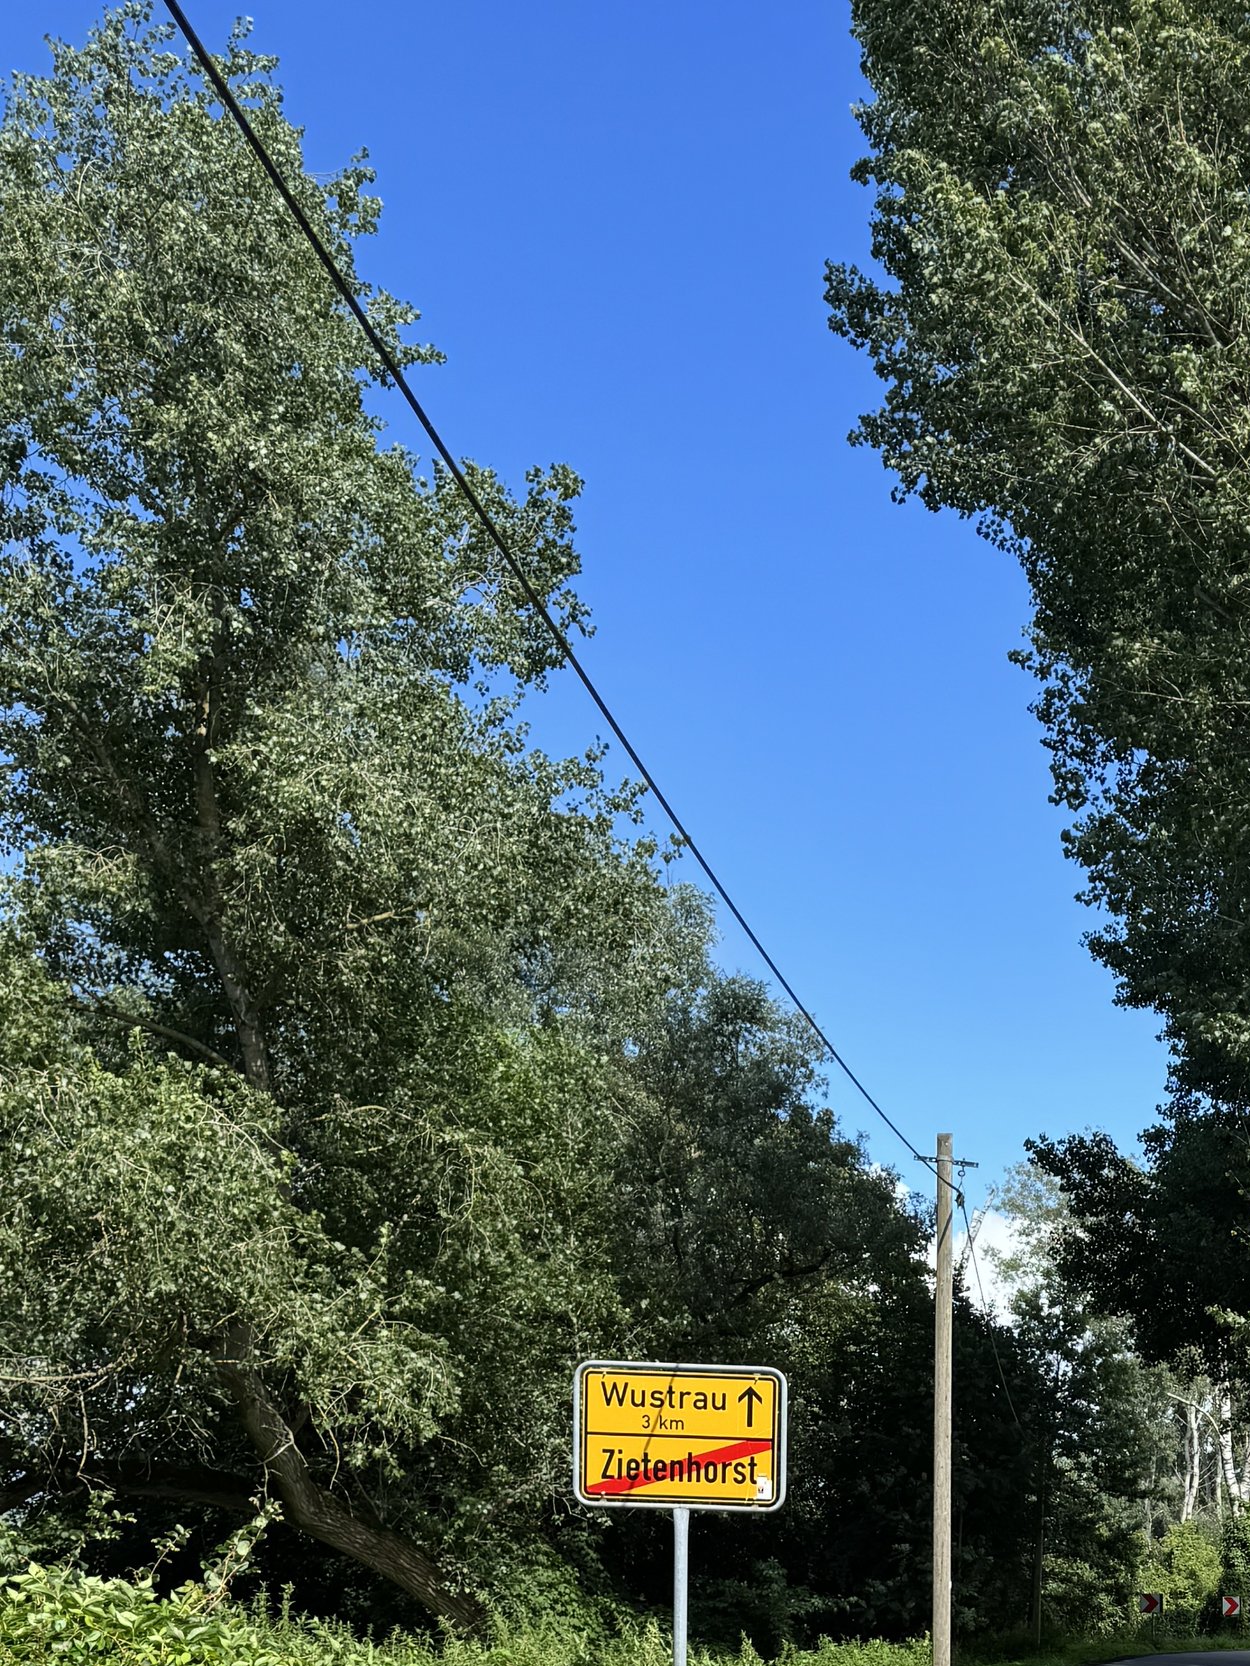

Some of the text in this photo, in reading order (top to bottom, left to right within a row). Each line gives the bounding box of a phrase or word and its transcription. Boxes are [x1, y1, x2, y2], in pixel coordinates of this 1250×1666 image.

[601, 1381, 727, 1411] Wustrau
[641, 1414, 685, 1431] 3 km
[601, 1448, 758, 1485] Zietenhorst
